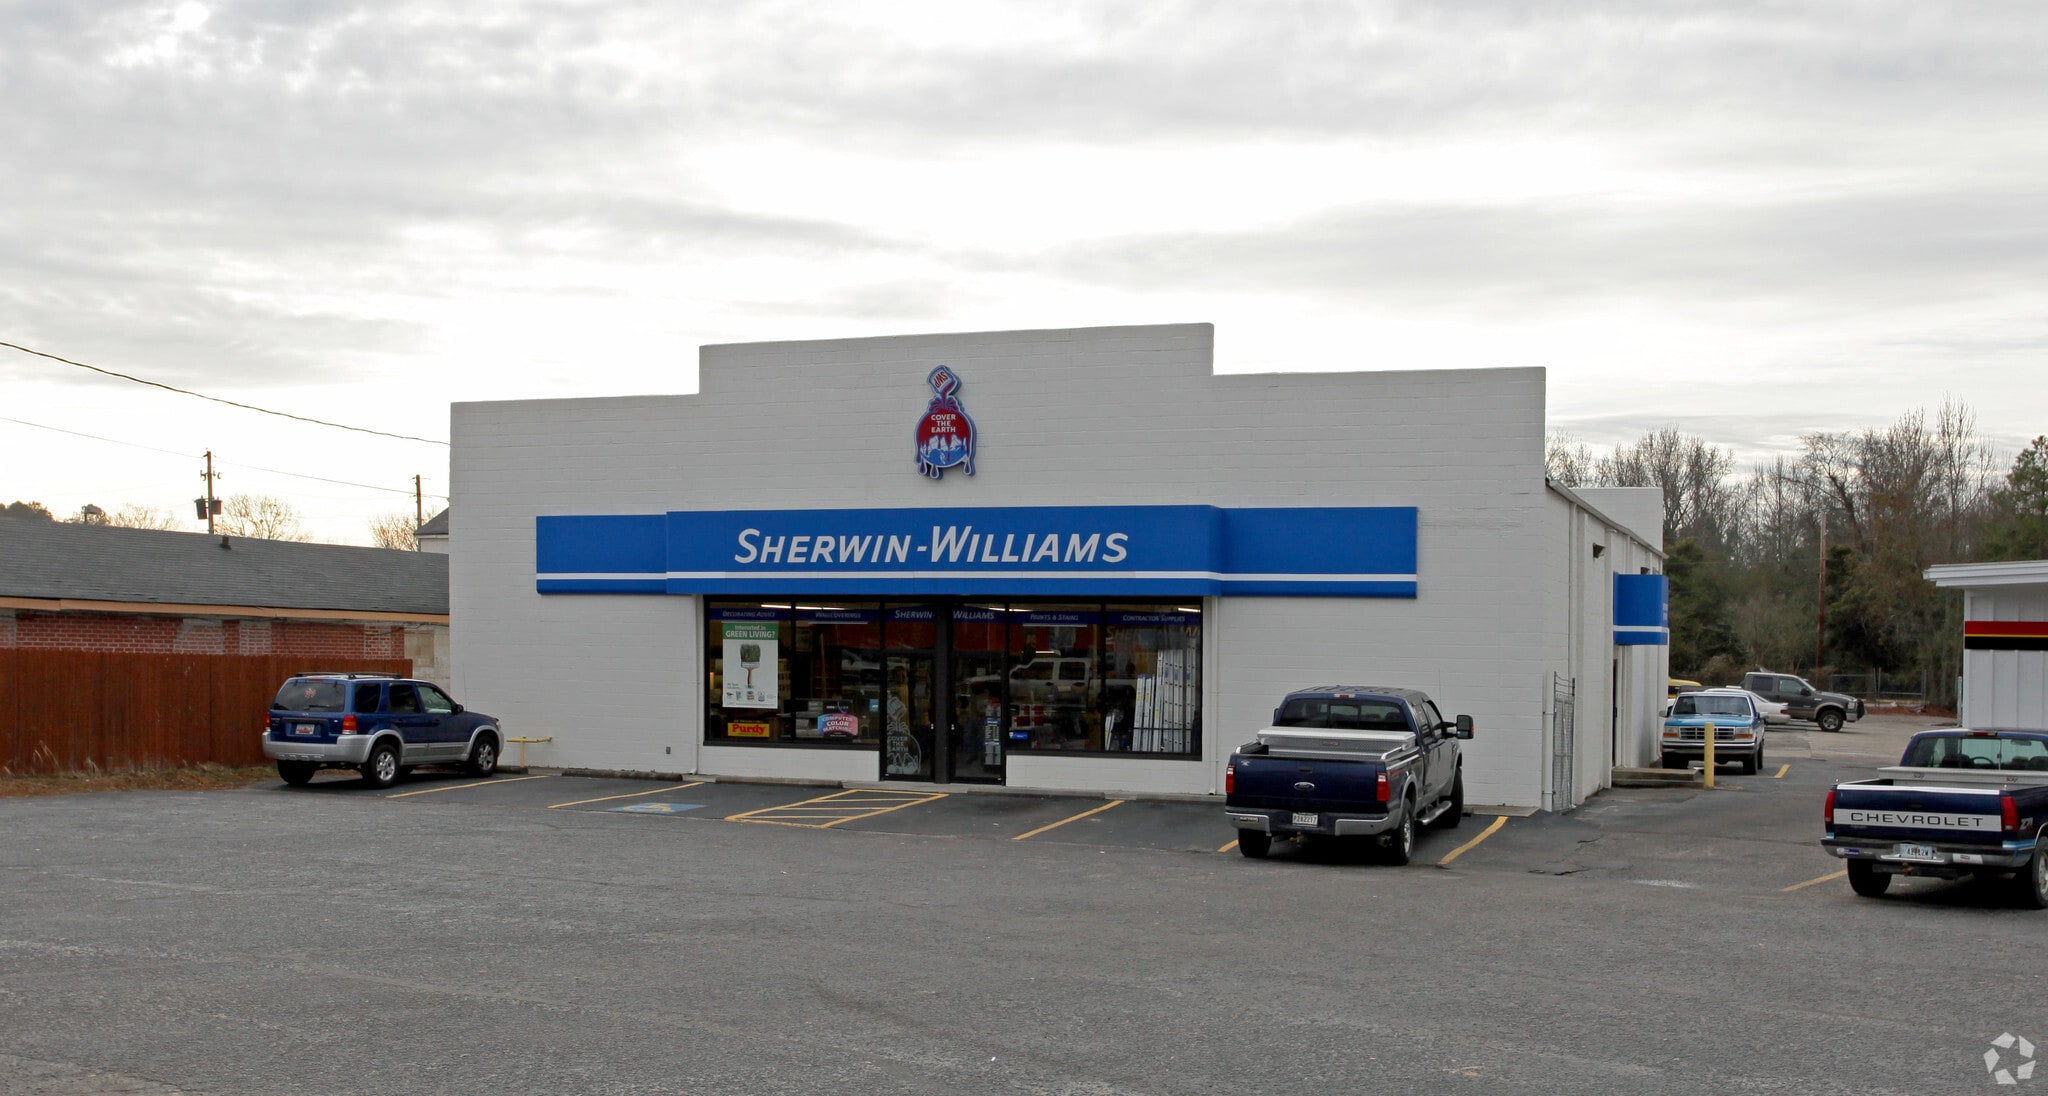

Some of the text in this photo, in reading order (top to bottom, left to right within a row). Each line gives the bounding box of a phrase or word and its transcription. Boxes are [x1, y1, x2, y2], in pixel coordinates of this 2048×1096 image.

[734, 525, 1129, 564] SHERWIN-WILLIAMS
[953, 610, 995, 620] WILLIAMS
[1030, 613, 1051, 621] PAINTS
[1122, 614, 1185, 622] CONTRACTOR SUPPLIES
[725, 630, 776, 638] GREEN LIVING?
[732, 723, 766, 735] Purdy
[1850, 812, 1984, 828] CHEVROLET
